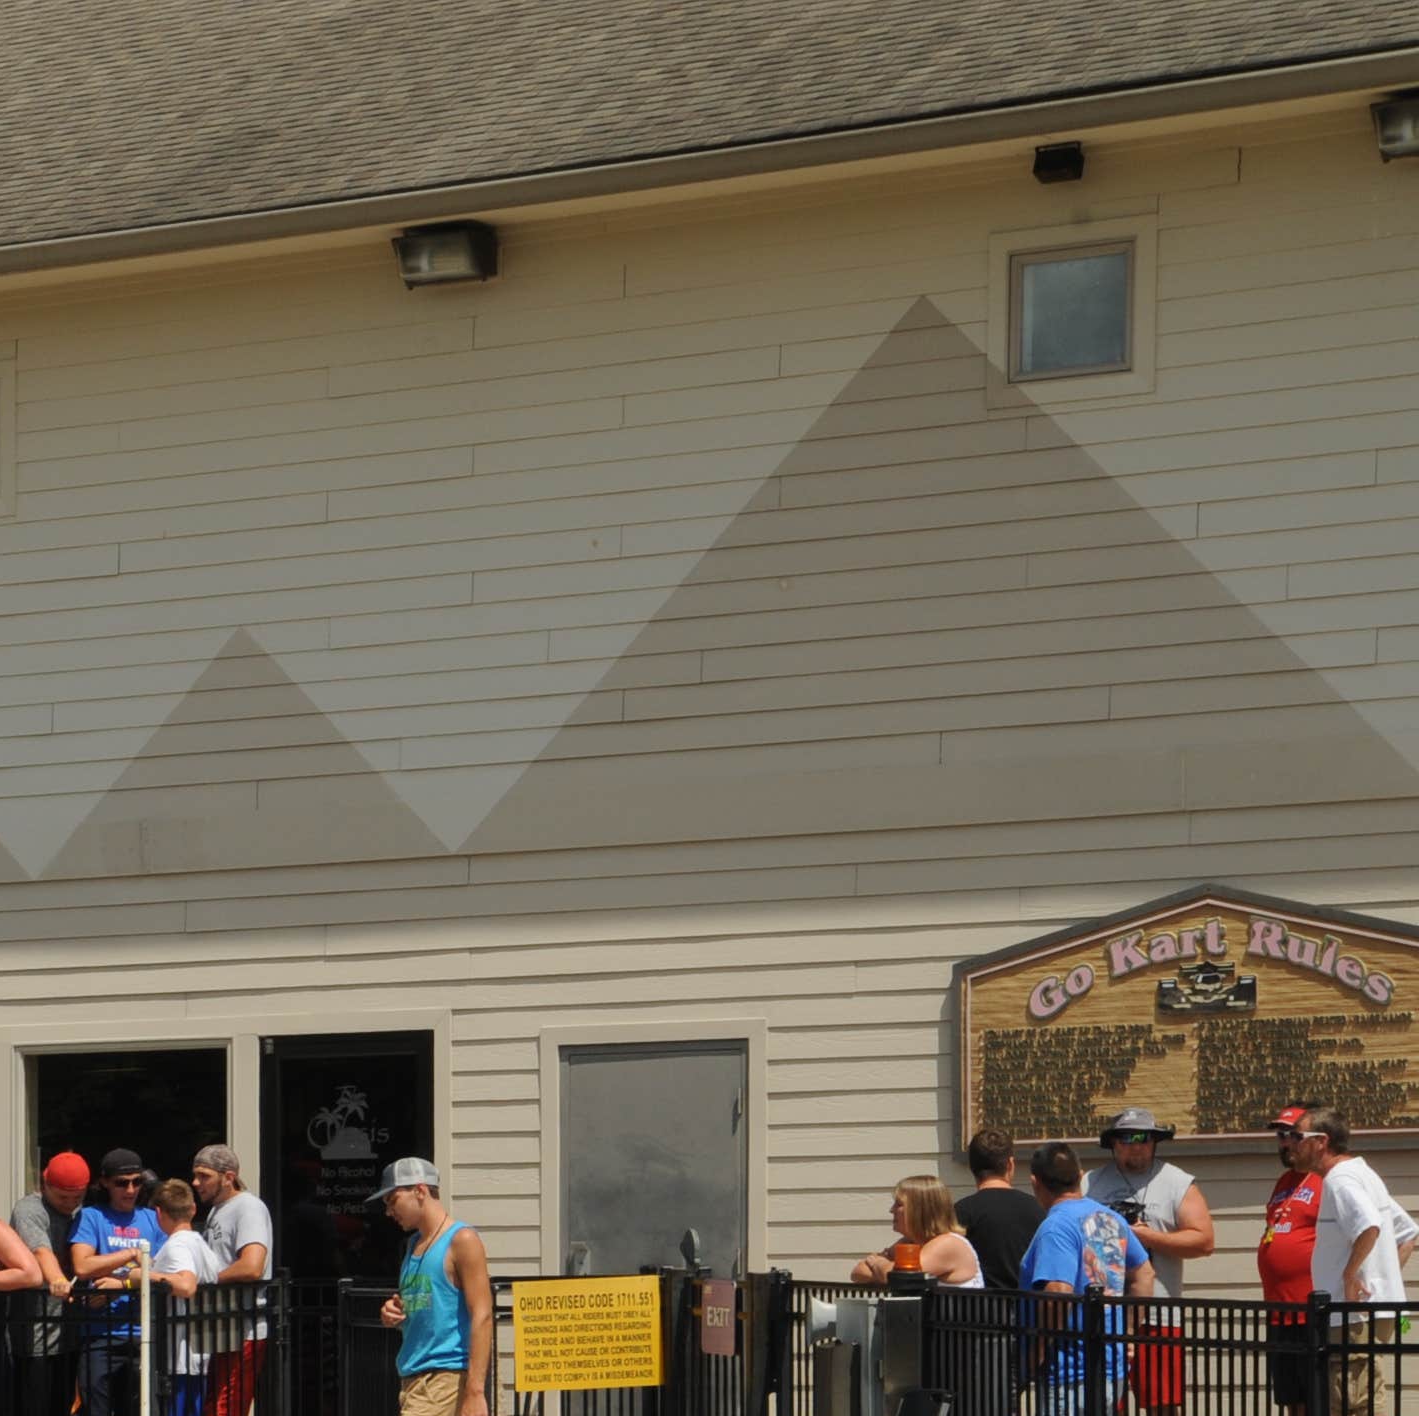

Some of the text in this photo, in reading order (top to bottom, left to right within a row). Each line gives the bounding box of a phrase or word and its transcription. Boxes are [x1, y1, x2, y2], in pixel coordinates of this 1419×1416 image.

[1027, 915, 1395, 1019] Go Kart Rules
[520, 1292, 653, 1311] OHIO REVISED CODE 1711.551
[522, 1310, 651, 1322] REQUIRES THAT ALL RIDERS MUST OBEY ALL
[706, 1306, 731, 1327] EXIT
[524, 1321, 651, 1334] WARNINGS AND DIRECTIONS REGARDING
[524, 1338, 539, 1346] THIS
[542, 1337, 558, 1345] RIDE
[561, 1336, 575, 1344] AND
[577, 1335, 605, 1344] BEHAVE
[607, 1334, 614, 1342] IN
[622, 1332, 651, 1341] MANNER
[525, 1345, 651, 1358] THAT WILL NOT CAUSE OR CONTRIBUTE
[524, 1357, 653, 1370] INJURY TO THEMSELVES OR OTHERS
[524, 1374, 551, 1383] FAILURE
[554, 1373, 562, 1382] TO
[564, 1372, 590, 1382] COMPLY
